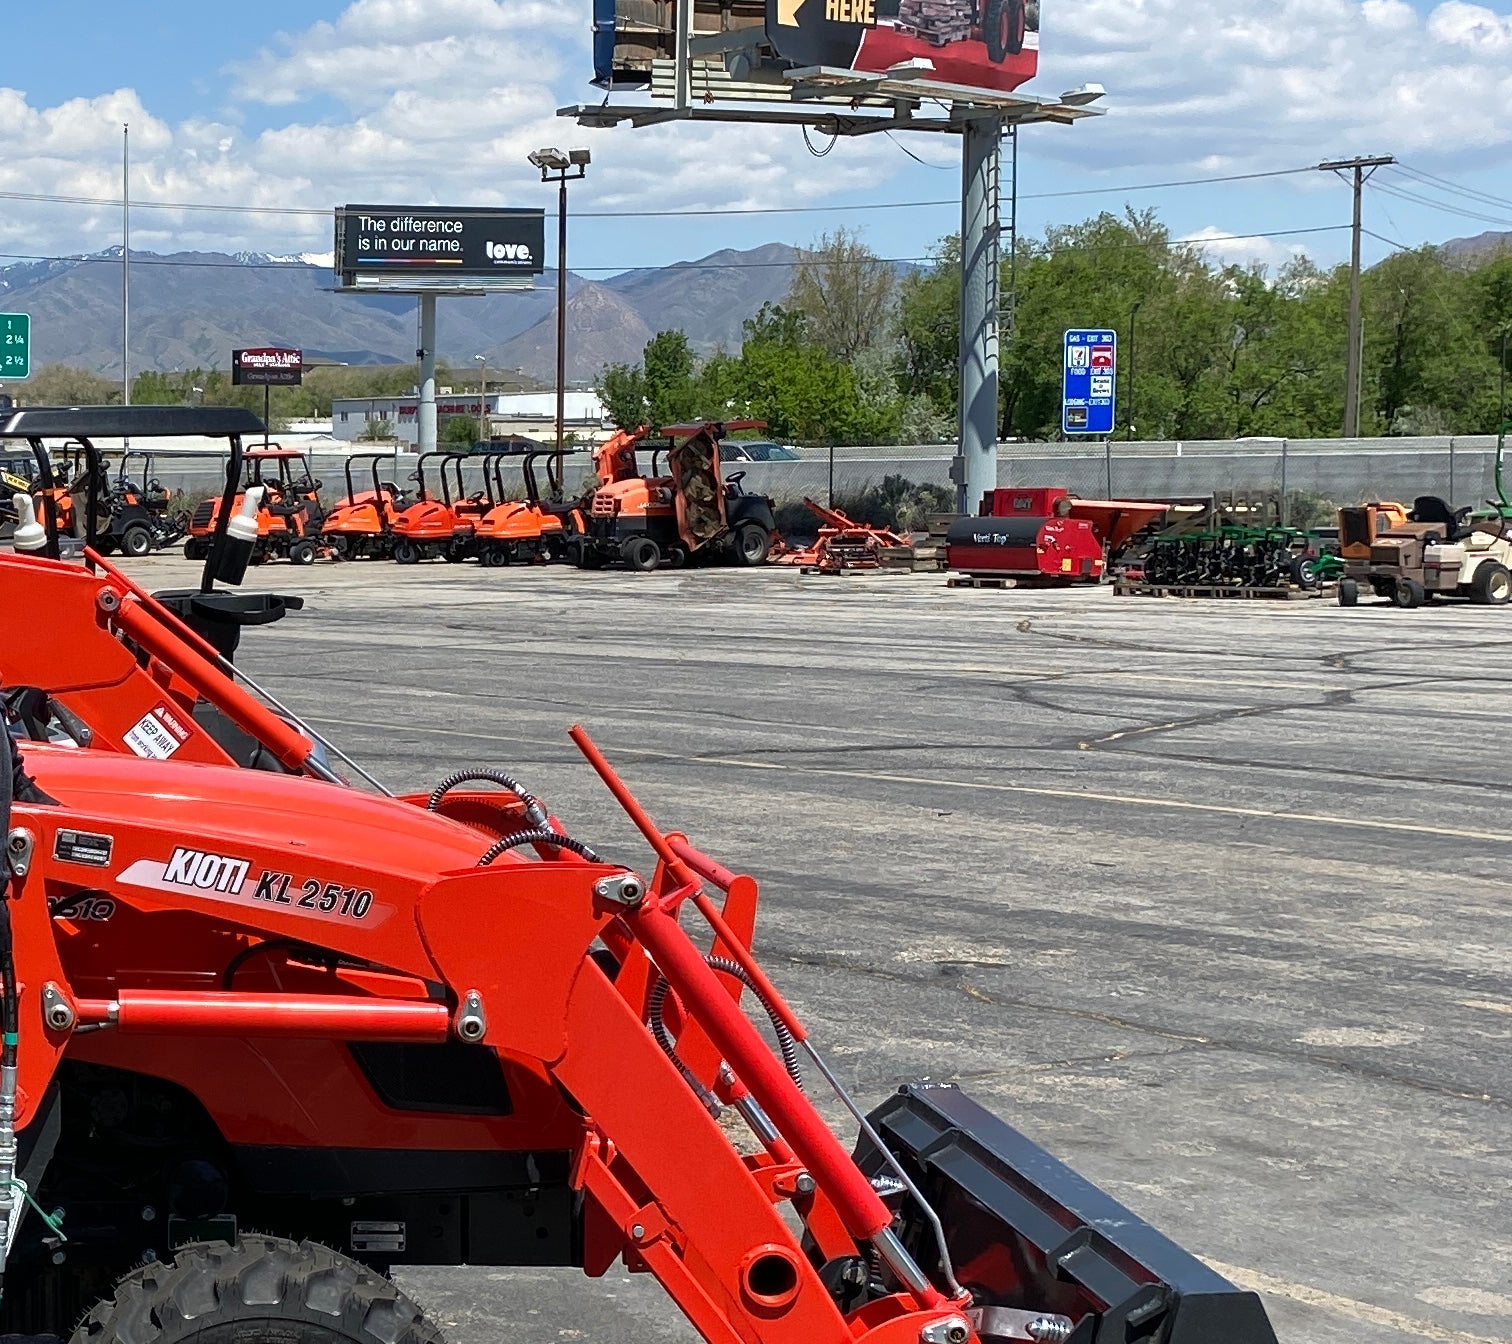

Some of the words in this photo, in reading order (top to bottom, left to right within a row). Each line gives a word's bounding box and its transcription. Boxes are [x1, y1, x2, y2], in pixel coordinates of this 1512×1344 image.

[358, 216, 386, 232] The
[390, 216, 463, 233] difference
[358, 235, 370, 251] is
[374, 235, 387, 251] in
[391, 238, 415, 251] our
[5, 335, 13, 345] 2
[5, 356, 13, 365] 2
[241, 351, 281, 365] Grandpa's
[139, 718, 158, 736] KEEP
[153, 734, 175, 754] AWAY
[163, 848, 251, 895] KIOTI
[254, 870, 292, 904] KL
[297, 880, 375, 920] 2510
